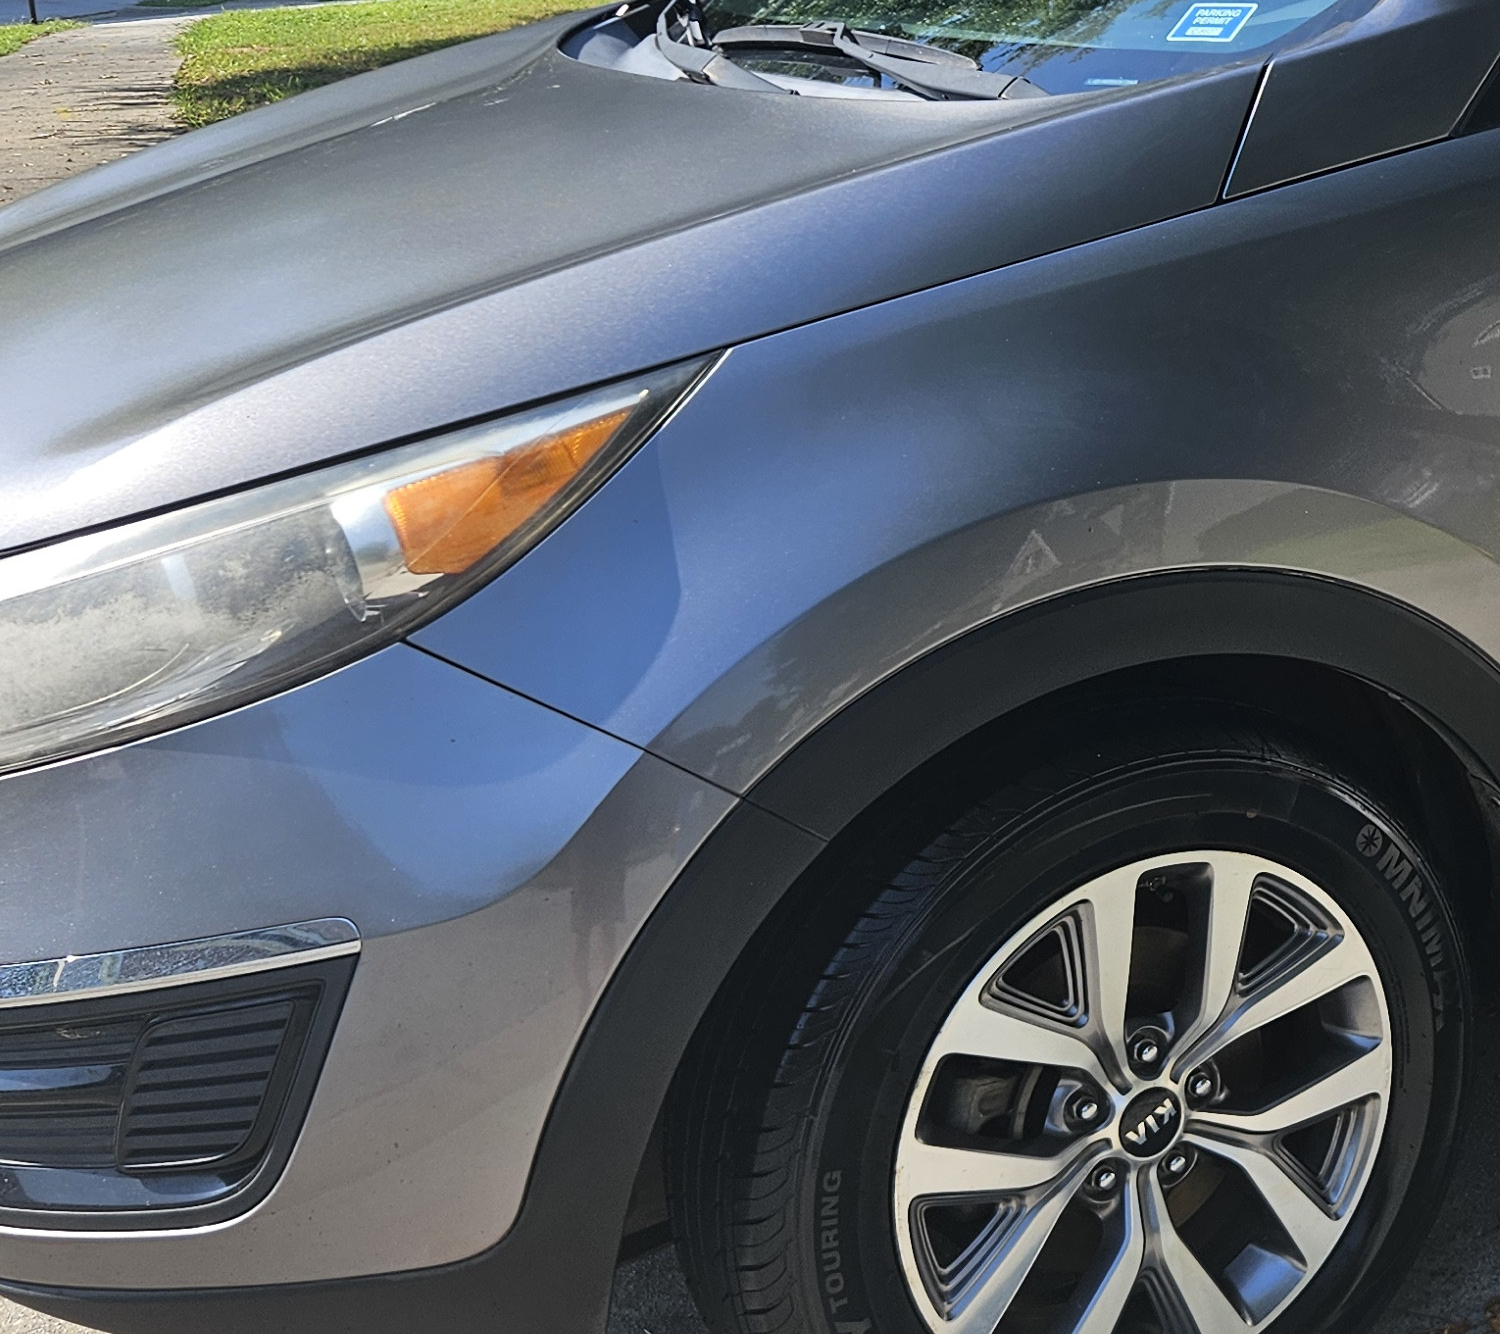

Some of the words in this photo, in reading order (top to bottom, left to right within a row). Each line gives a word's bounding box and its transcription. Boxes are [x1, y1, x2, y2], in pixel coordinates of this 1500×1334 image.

[1192, 17, 1234, 26] PERMIT
[1195, 8, 1242, 17] PARKING
[1125, 1097, 1177, 1145] KIA
[820, 1170, 848, 1315] TOURING
